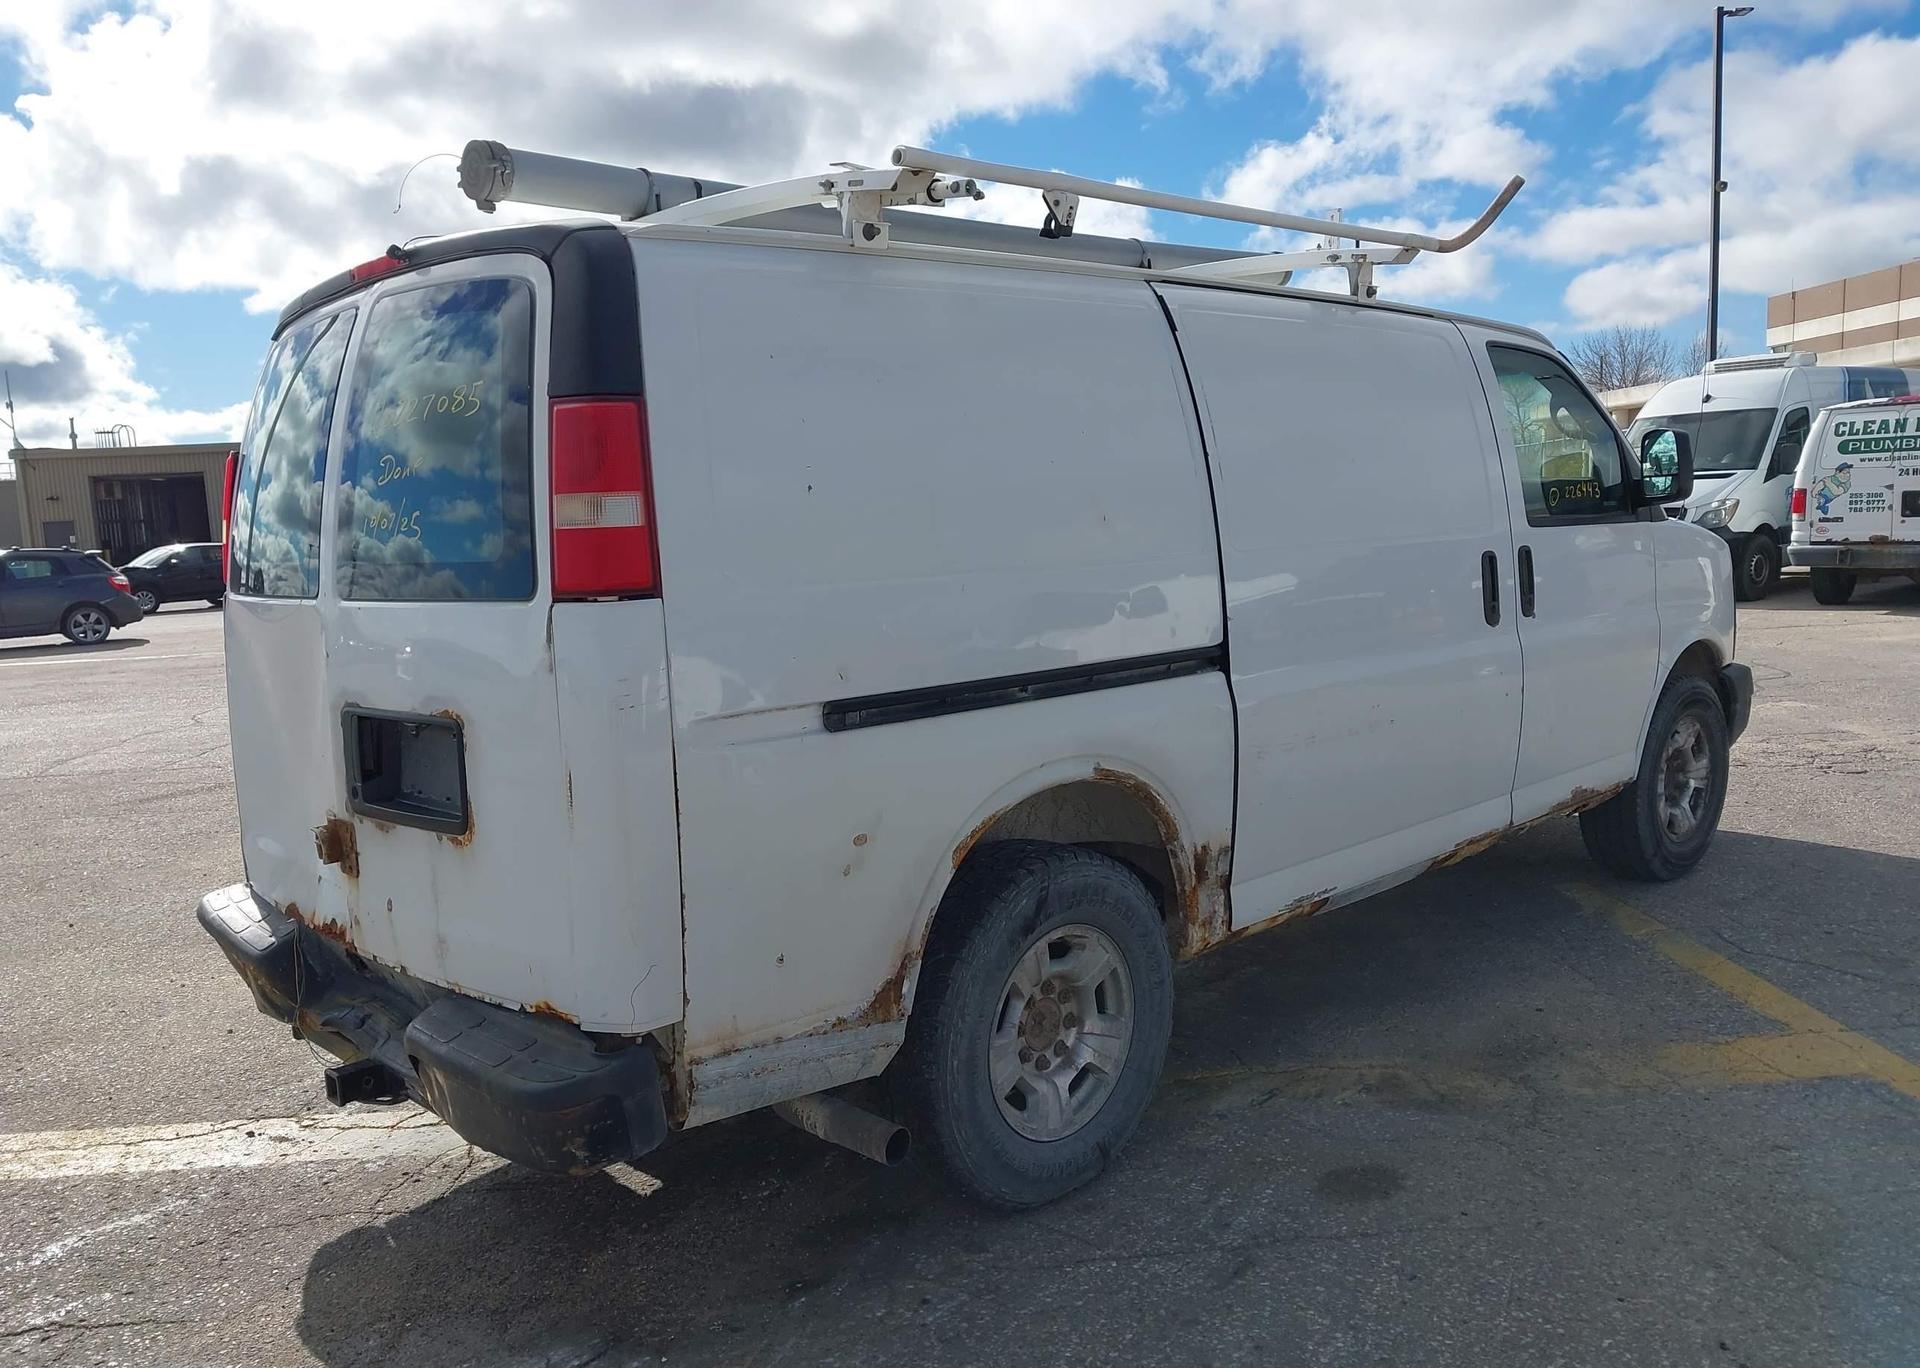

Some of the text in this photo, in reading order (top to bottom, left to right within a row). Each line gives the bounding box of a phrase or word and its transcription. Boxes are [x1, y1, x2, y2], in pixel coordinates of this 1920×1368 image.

[1834, 417, 1909, 437] CLEAN
[1898, 468, 1910, 477] 24
[1565, 480, 1601, 498] 226443
